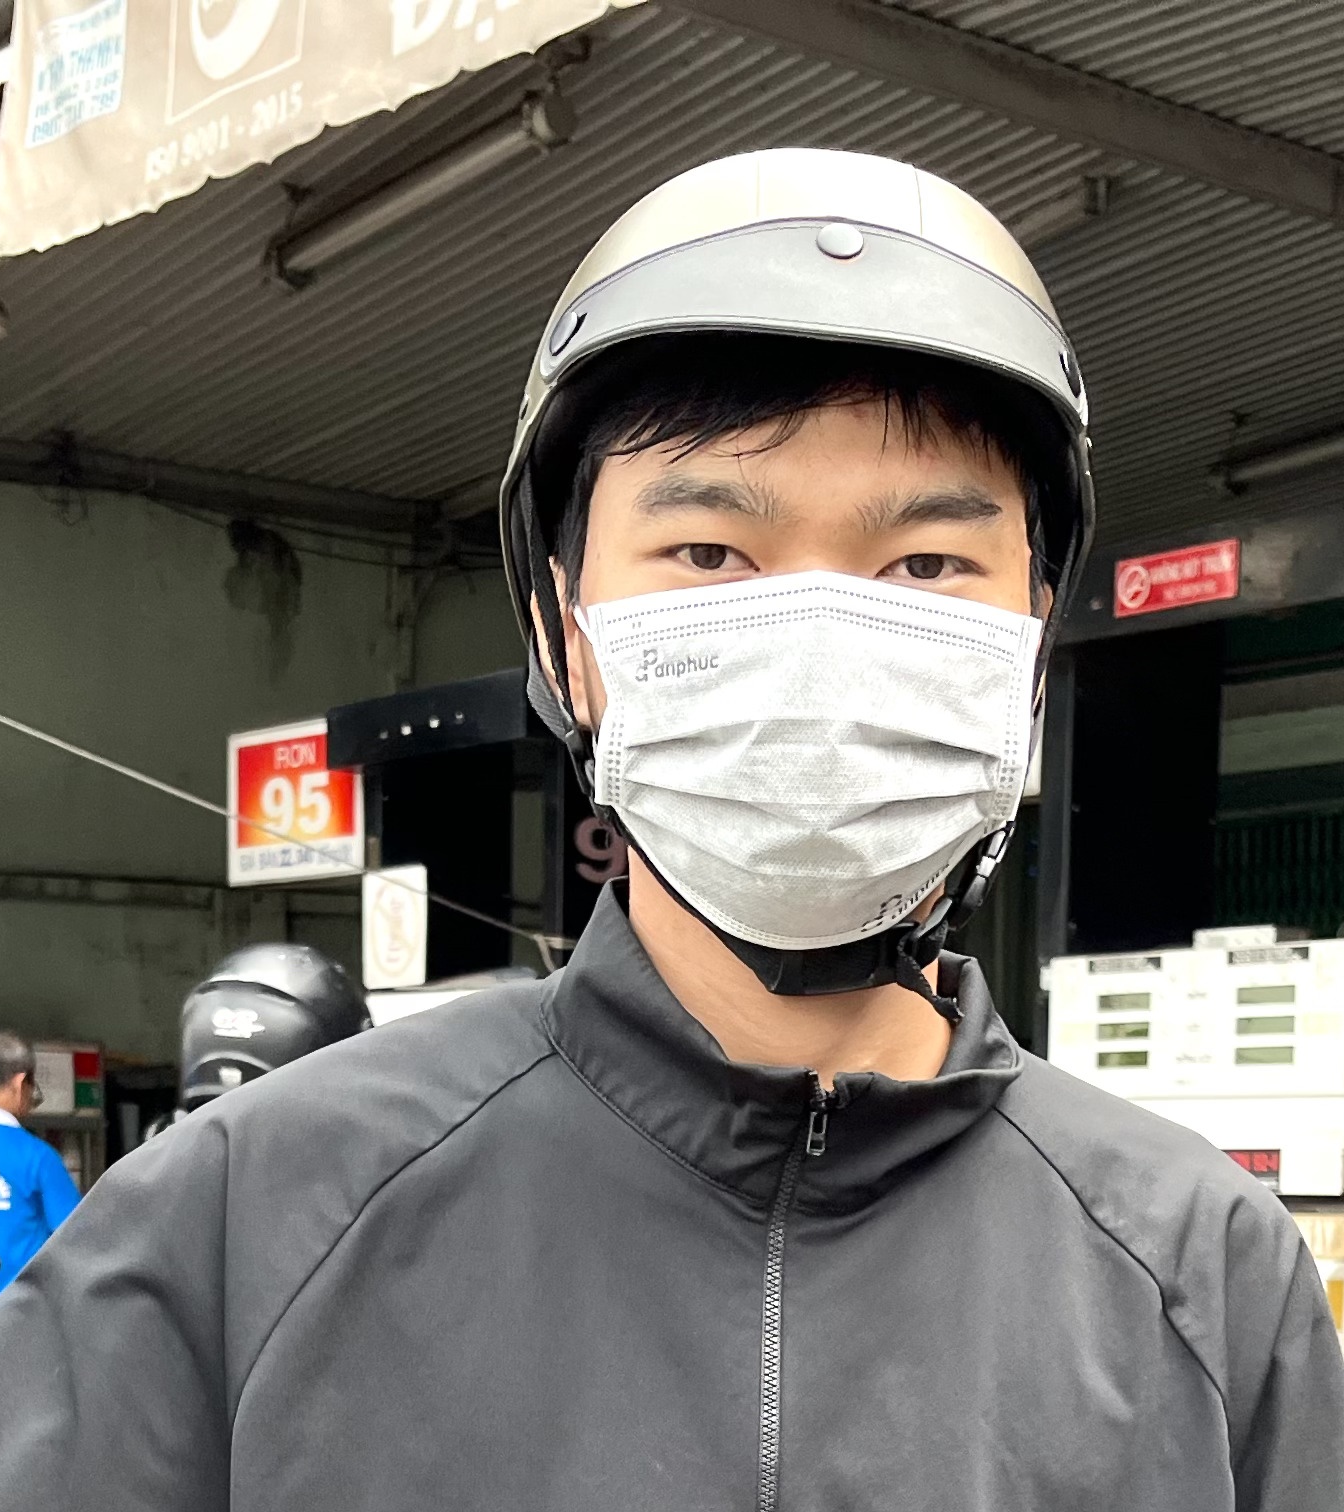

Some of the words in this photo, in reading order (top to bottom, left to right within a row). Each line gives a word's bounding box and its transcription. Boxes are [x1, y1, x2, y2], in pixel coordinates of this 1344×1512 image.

[273, 741, 316, 770] RON
[260, 771, 332, 836] 95
[575, 816, 627, 884] 9
